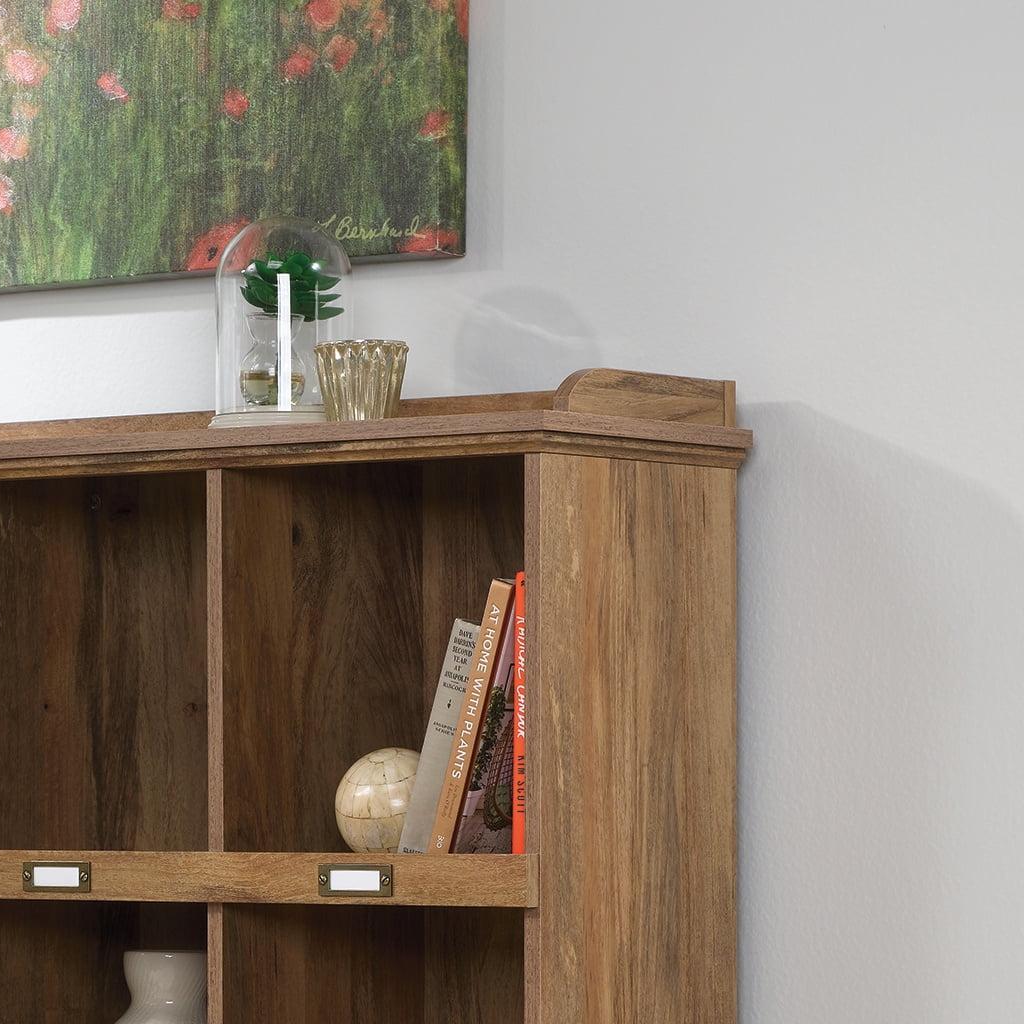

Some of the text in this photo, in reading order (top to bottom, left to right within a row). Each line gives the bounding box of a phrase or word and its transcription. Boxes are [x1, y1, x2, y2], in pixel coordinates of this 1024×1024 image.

[459, 628, 473, 640] DAVE
[452, 645, 473, 658] SECOND
[453, 654, 468, 666] YEAR
[451, 604, 501, 779] AT HOME WITH PLANTS
